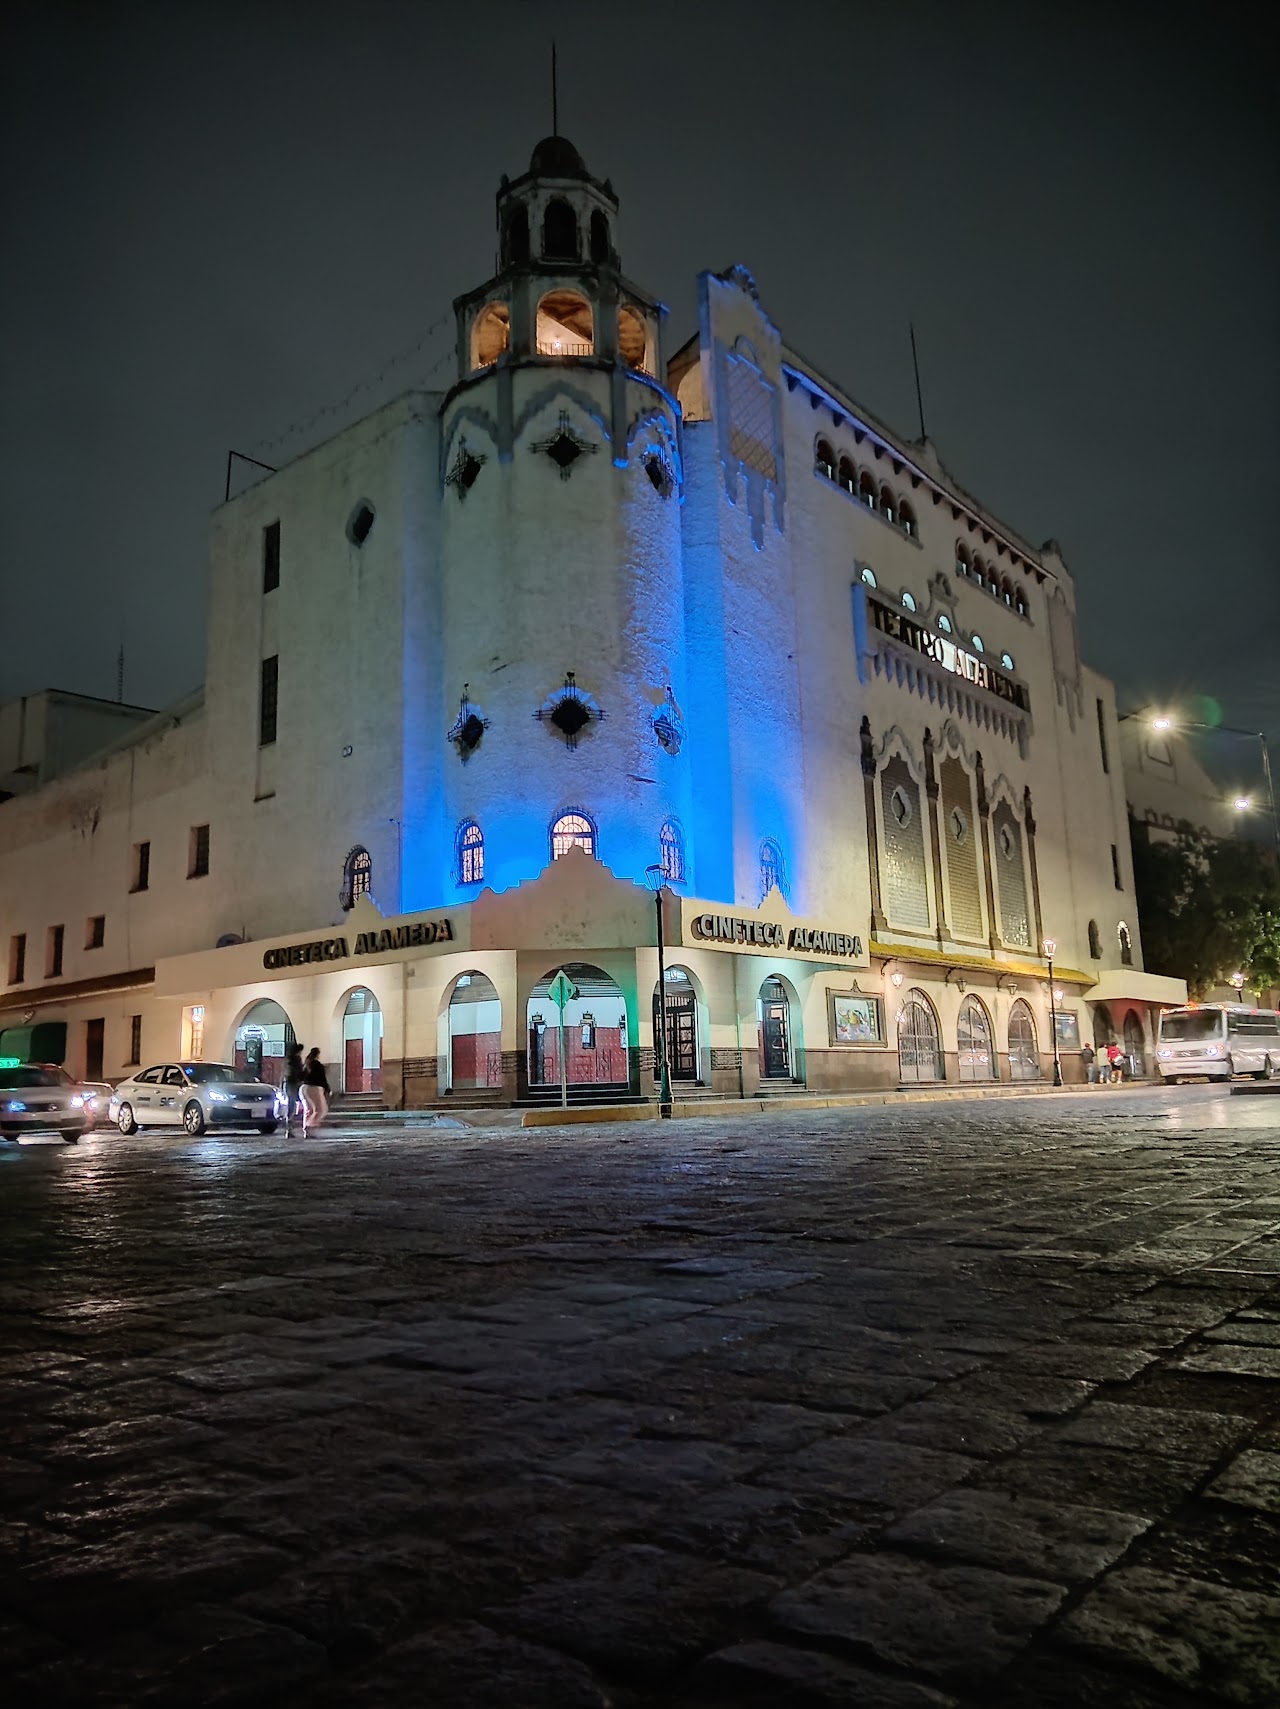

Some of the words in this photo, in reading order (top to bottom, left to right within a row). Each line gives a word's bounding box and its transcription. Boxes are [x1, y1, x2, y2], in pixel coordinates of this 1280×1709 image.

[263, 937, 348, 969] CINETECA
[354, 918, 453, 954] ALAMEDA
[699, 913, 785, 946] CINETECA
[793, 927, 864, 955] ALAMEDA
